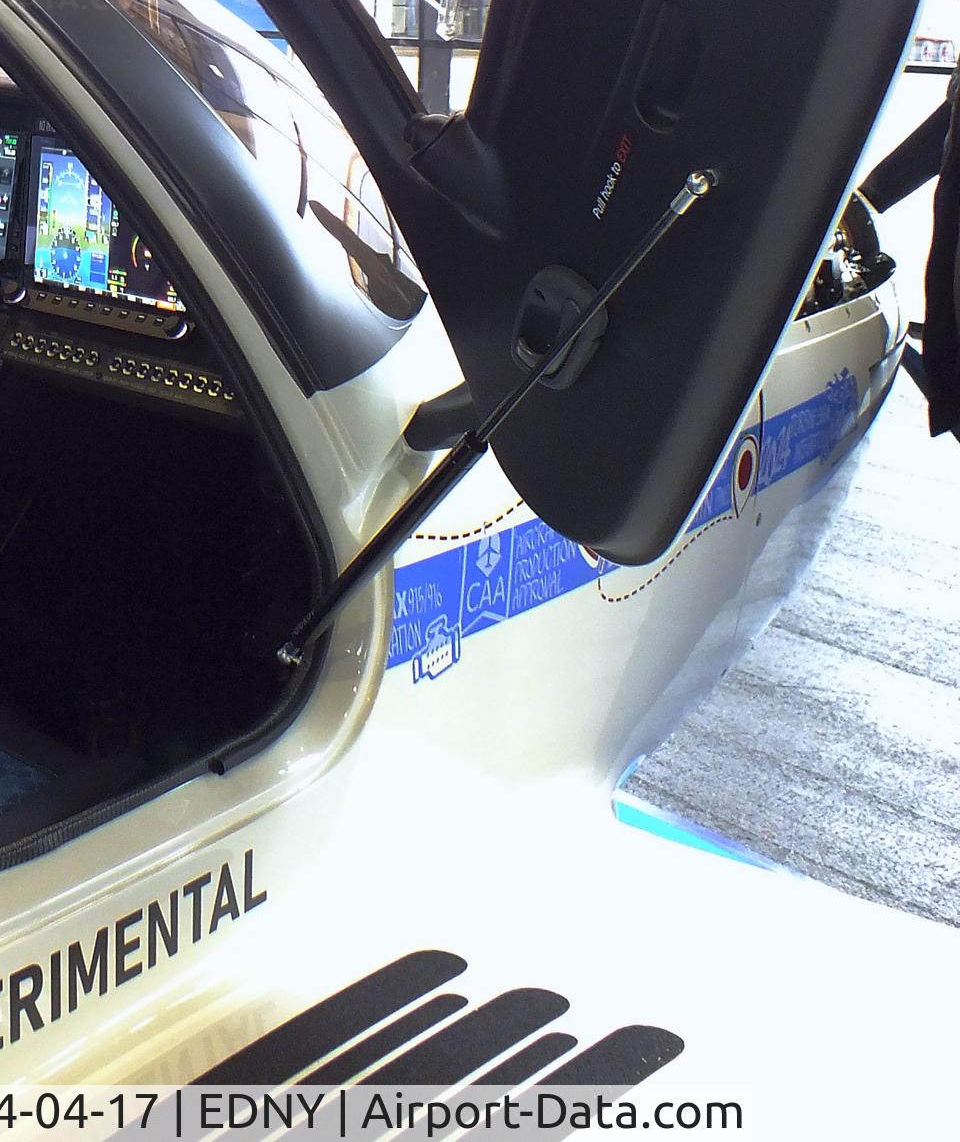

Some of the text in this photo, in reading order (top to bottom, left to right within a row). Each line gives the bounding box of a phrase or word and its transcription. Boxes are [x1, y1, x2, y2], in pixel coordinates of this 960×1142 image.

[592, 197, 606, 220] Pull
[600, 173, 617, 201] hook
[611, 161, 621, 176] to
[467, 576, 506, 613] CAA
[388, 620, 422, 658] ATION
